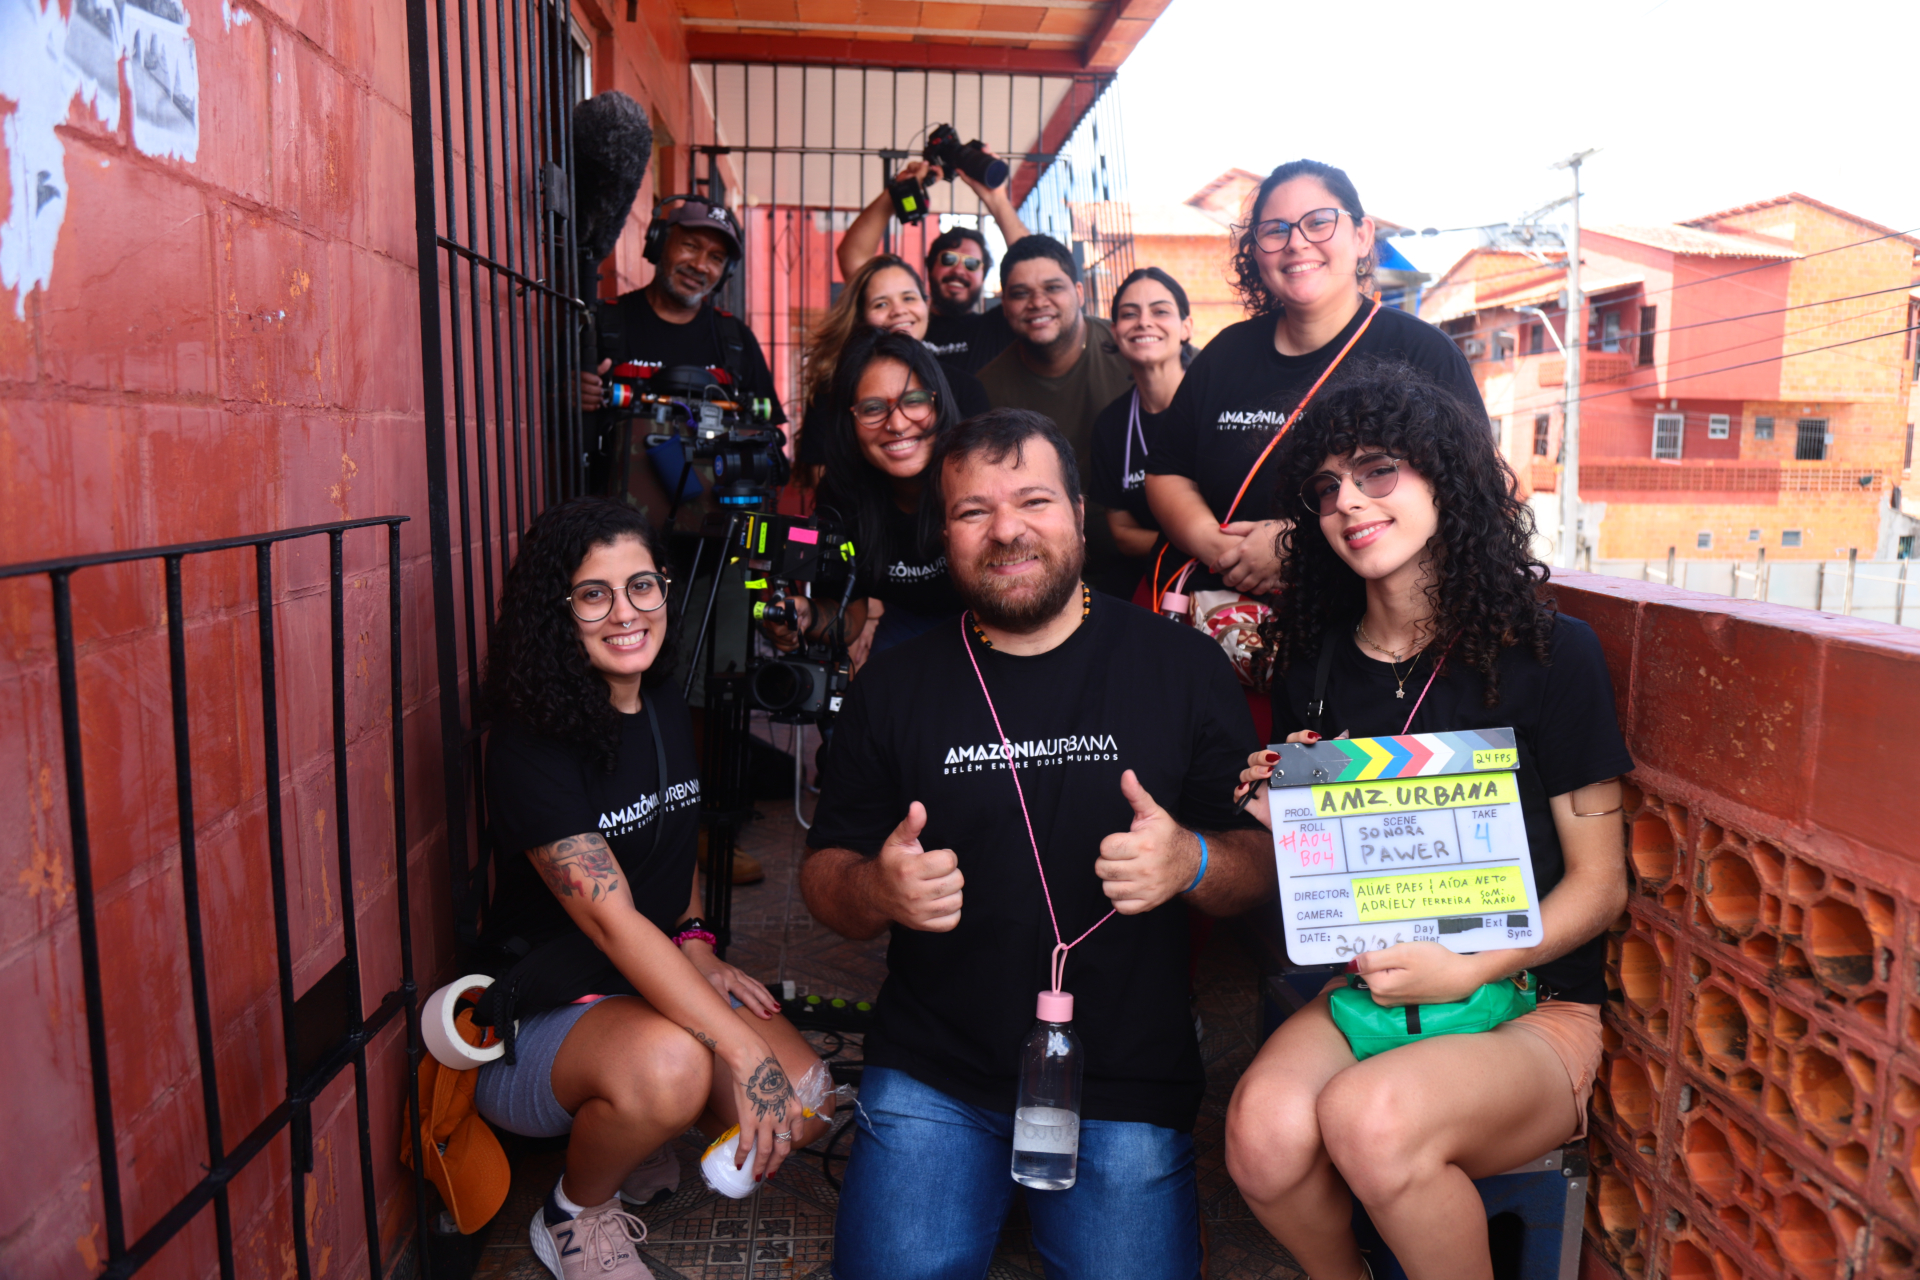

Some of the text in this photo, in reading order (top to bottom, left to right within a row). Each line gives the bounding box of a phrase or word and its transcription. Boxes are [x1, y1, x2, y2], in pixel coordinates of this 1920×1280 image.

[944, 754, 1119, 775] BELÉM ENTRE DOIS MUNDOS
[1475, 753, 1511, 764] 24 FPS
[1396, 780, 1498, 806] URBANA
[605, 826, 634, 838] ELÉM
[680, 795, 701, 808] MUND
[1284, 807, 1313, 818] PROD.
[1472, 809, 1498, 819] TAKE
[1300, 822, 1326, 832] ROLL
[1383, 815, 1417, 827] SCENE
[1358, 825, 1425, 841] SONORA
[1474, 822, 1492, 853] 4
[1360, 840, 1450, 865] PAWER
[1300, 849, 1334, 870] B04
[1396, 882, 1423, 894] PAES
[1475, 875, 1507, 885] NETO
[1294, 888, 1350, 901] DIRECTOR:
[1296, 909, 1343, 921] CAMERA:
[1414, 924, 1435, 934] Day
[1485, 918, 1503, 928] Ext
[1300, 932, 1331, 943] DATE:
[1507, 929, 1533, 940] Sync
